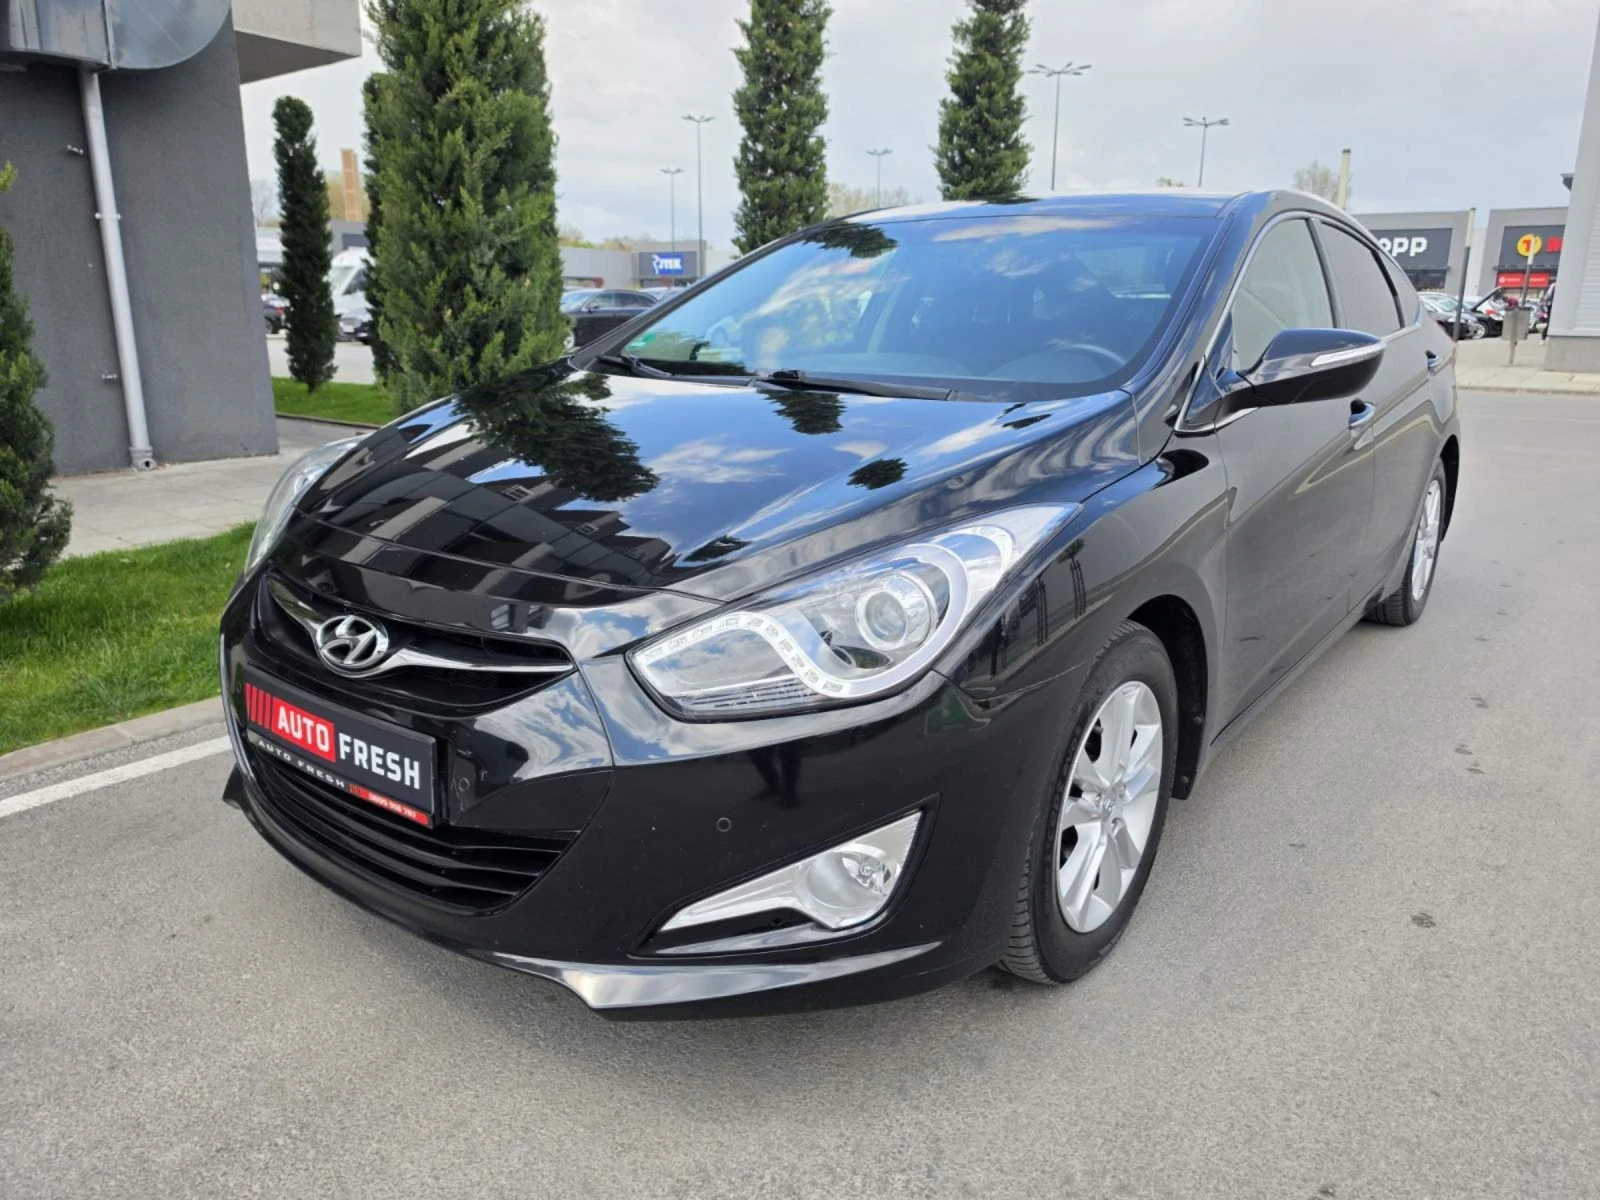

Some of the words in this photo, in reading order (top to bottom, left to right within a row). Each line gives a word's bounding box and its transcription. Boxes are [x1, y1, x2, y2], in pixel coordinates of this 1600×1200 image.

[258, 739, 292, 761] AUTO
[297, 760, 345, 788] FRESH
[277, 706, 330, 753] AUTO
[339, 732, 421, 790] FRESH
